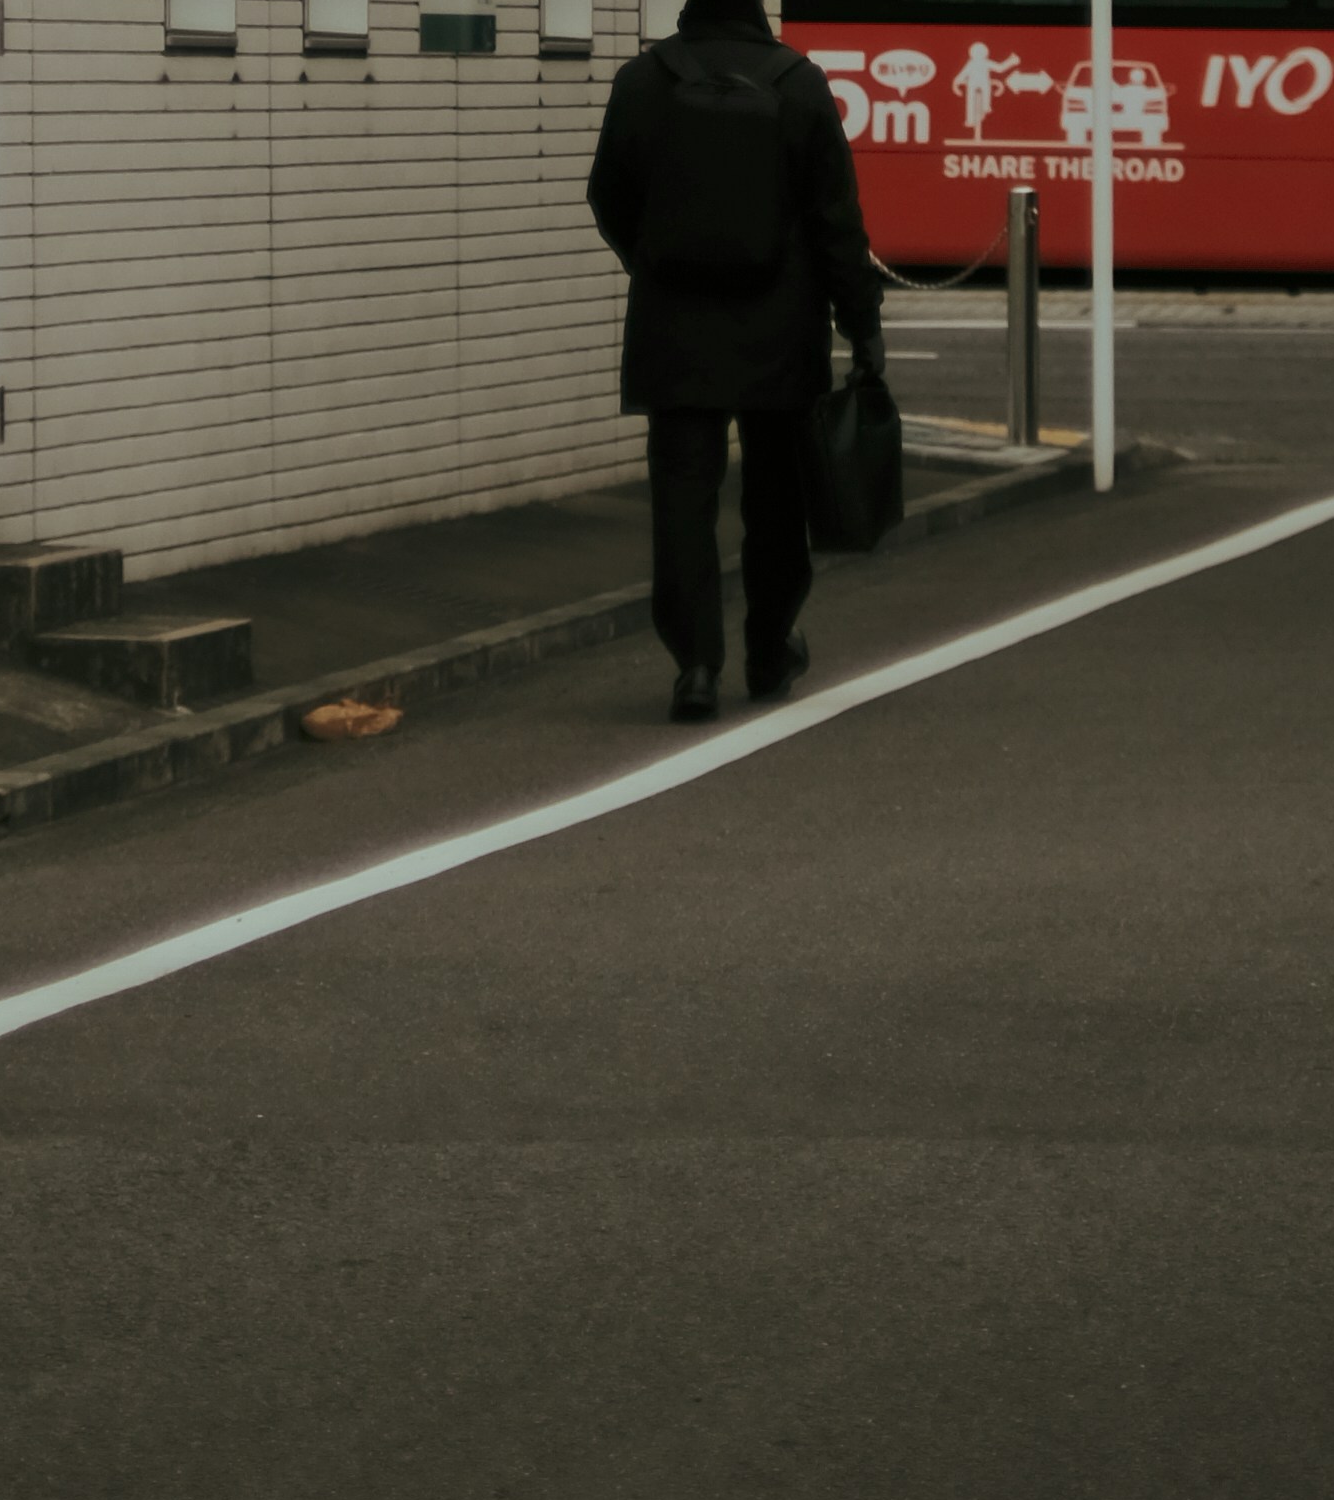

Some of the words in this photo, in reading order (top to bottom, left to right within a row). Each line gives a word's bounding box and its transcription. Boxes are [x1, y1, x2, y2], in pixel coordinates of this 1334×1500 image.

[942, 153, 1036, 179] SHARE
[1043, 155, 1093, 180] THE
[1111, 157, 1185, 182] ROAD
